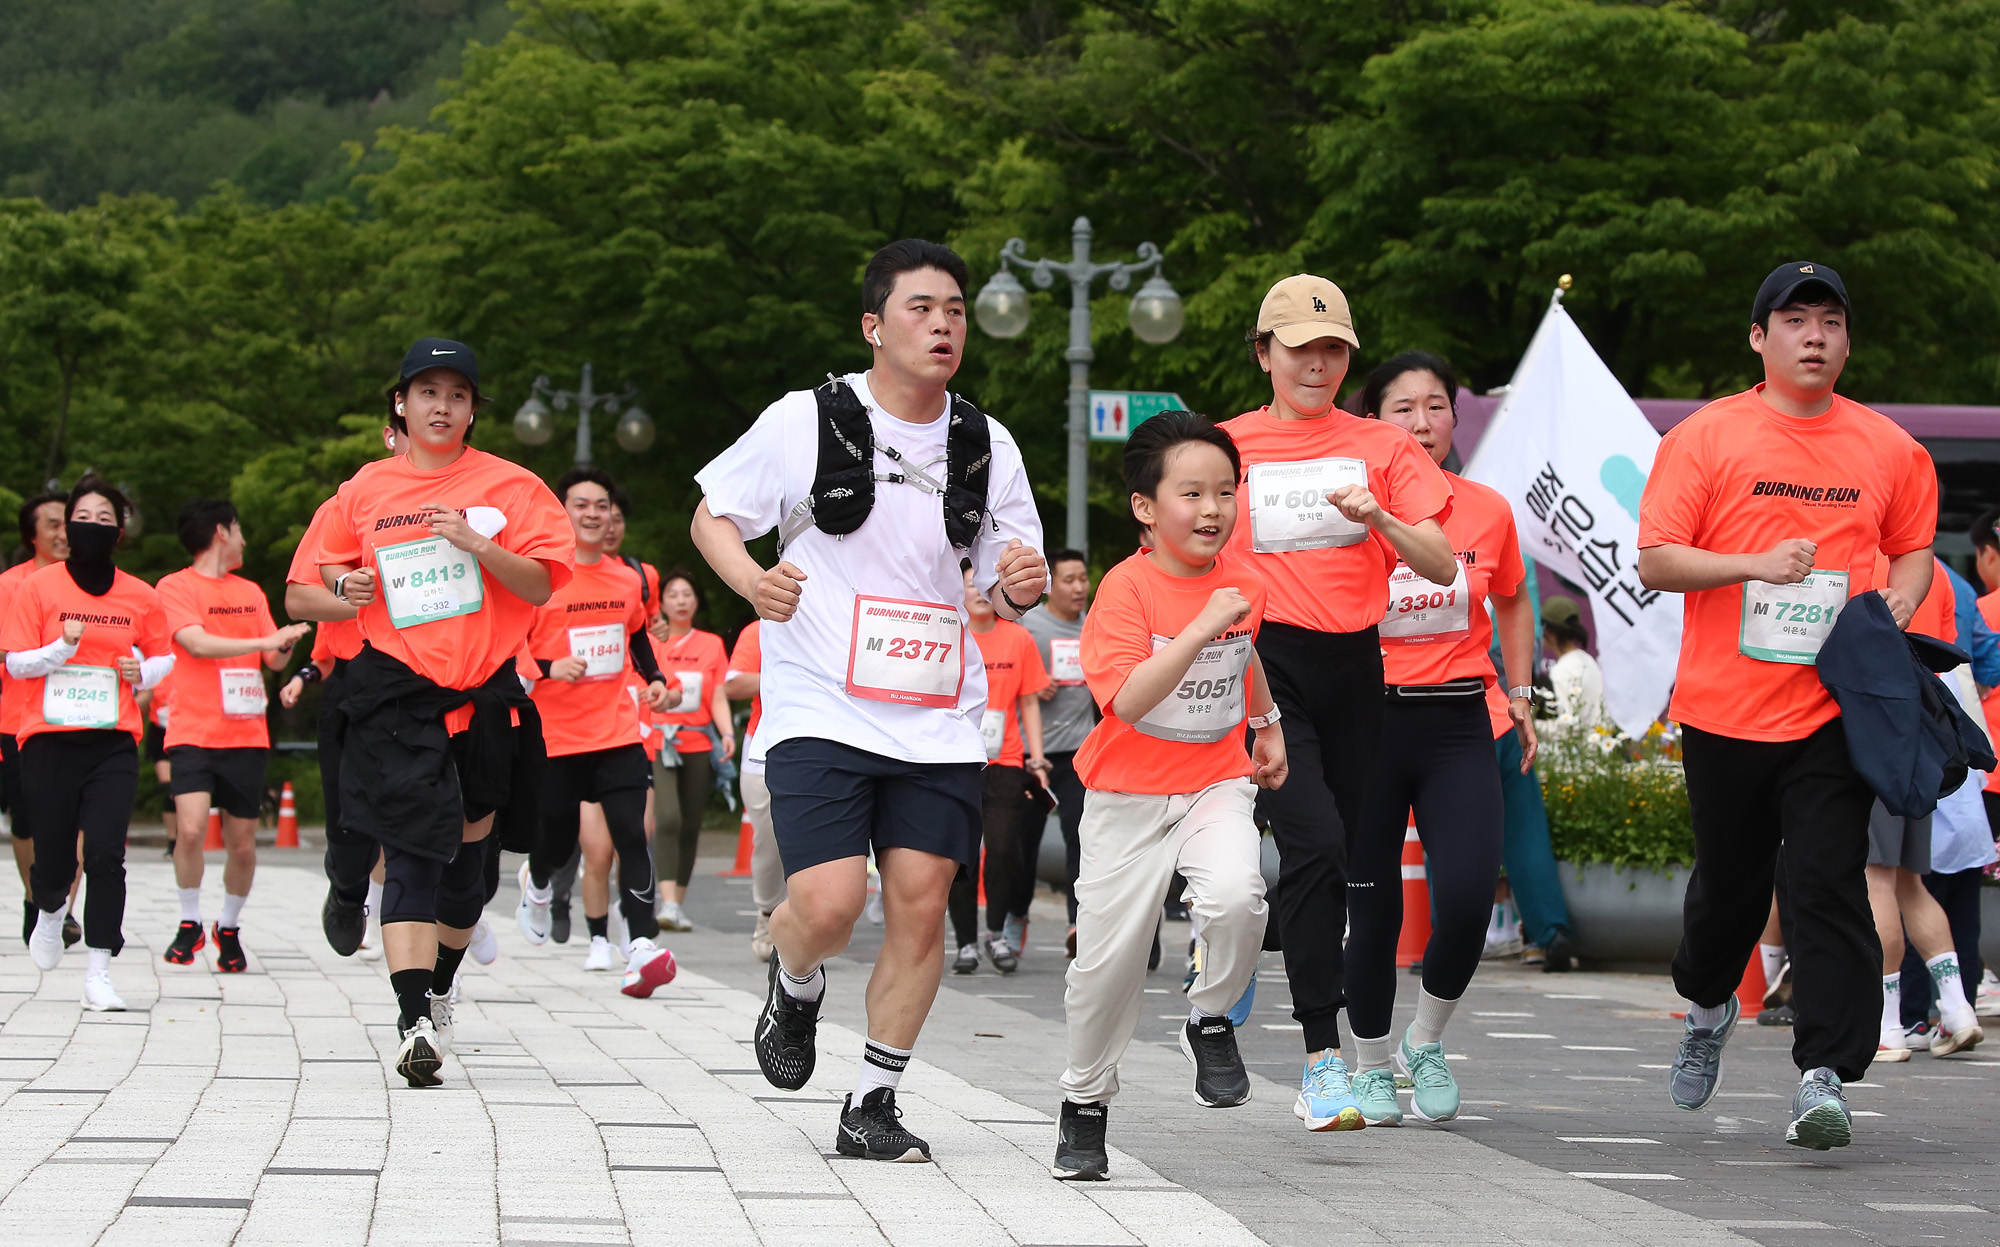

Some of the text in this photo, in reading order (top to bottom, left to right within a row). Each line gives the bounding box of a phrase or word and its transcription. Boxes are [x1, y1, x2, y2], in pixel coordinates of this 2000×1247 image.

[1312, 297, 1327, 312] LA
[1260, 467, 1302, 477] BURNING
[1304, 465, 1324, 474] RUN
[1263, 488, 1336, 509] W 605
[1752, 481, 1861, 502] BURNING RUN
[1298, 512, 1324, 521] 방지연
[385, 548, 418, 561] BURNING
[421, 545, 437, 553] RUN
[391, 562, 466, 589] W 8413
[1828, 580, 1844, 588] 7km
[421, 600, 450, 612] C-332
[566, 600, 625, 613] BURNING RUN
[1398, 589, 1456, 613] 3301
[208, 606, 242, 615] BURNING
[866, 606, 931, 623] BURNING RUN
[1753, 601, 1835, 625] M 7281
[110, 616, 131, 626] RUN
[939, 616, 958, 626] 10km
[1783, 625, 1807, 636] 이은성
[577, 643, 620, 657] M 1844
[866, 637, 952, 663] M 2377
[1204, 650, 1224, 661] RUN
[1234, 647, 1246, 656] 5km
[1176, 673, 1238, 700] 5057
[53, 687, 108, 703] W 8245
